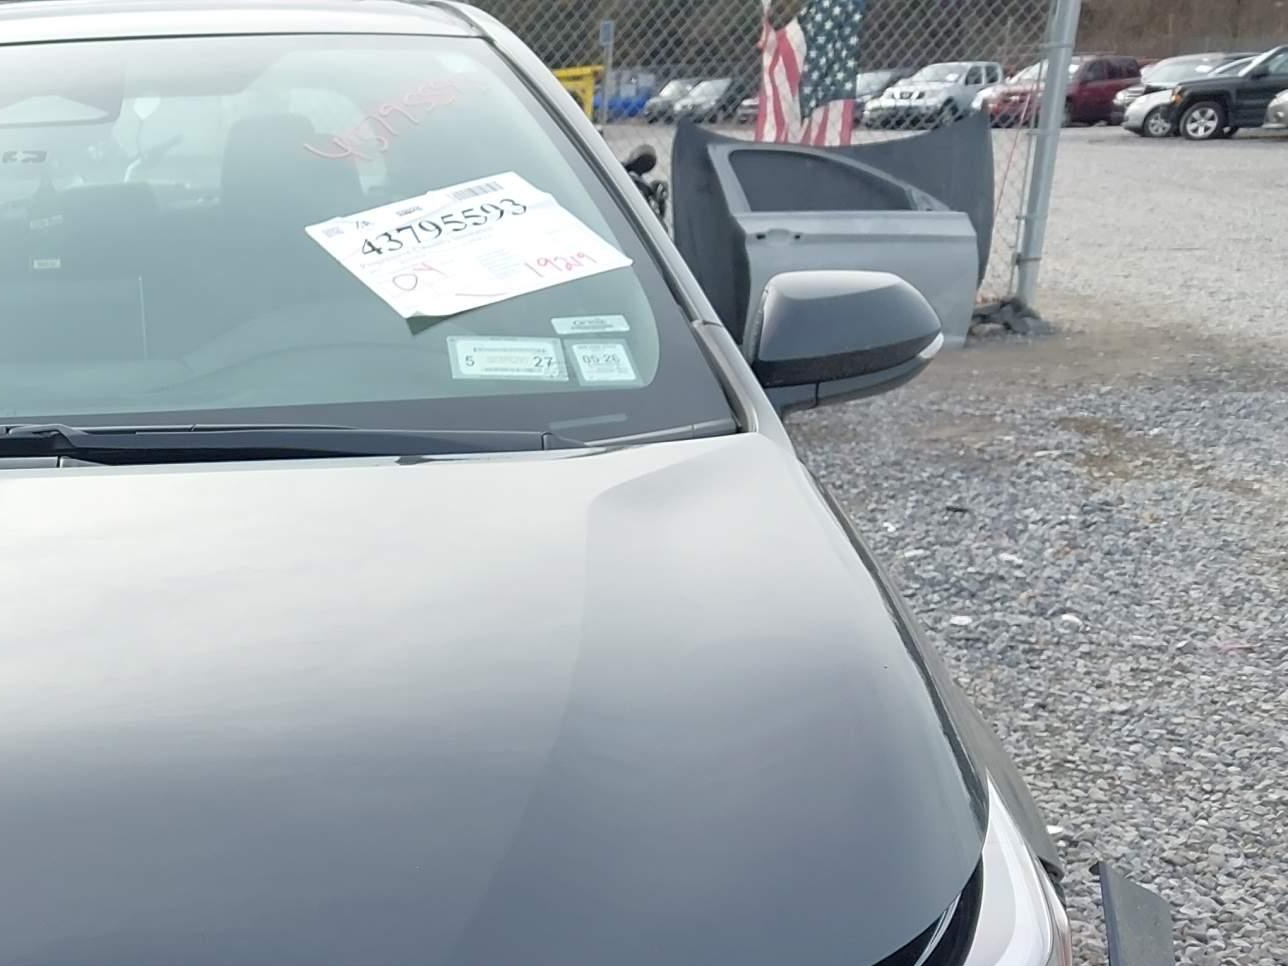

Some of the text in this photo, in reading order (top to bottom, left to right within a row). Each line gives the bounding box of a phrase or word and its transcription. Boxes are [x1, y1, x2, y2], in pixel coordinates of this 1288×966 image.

[361, 198, 527, 255] 43795593
[465, 355, 554, 369] 5 27
